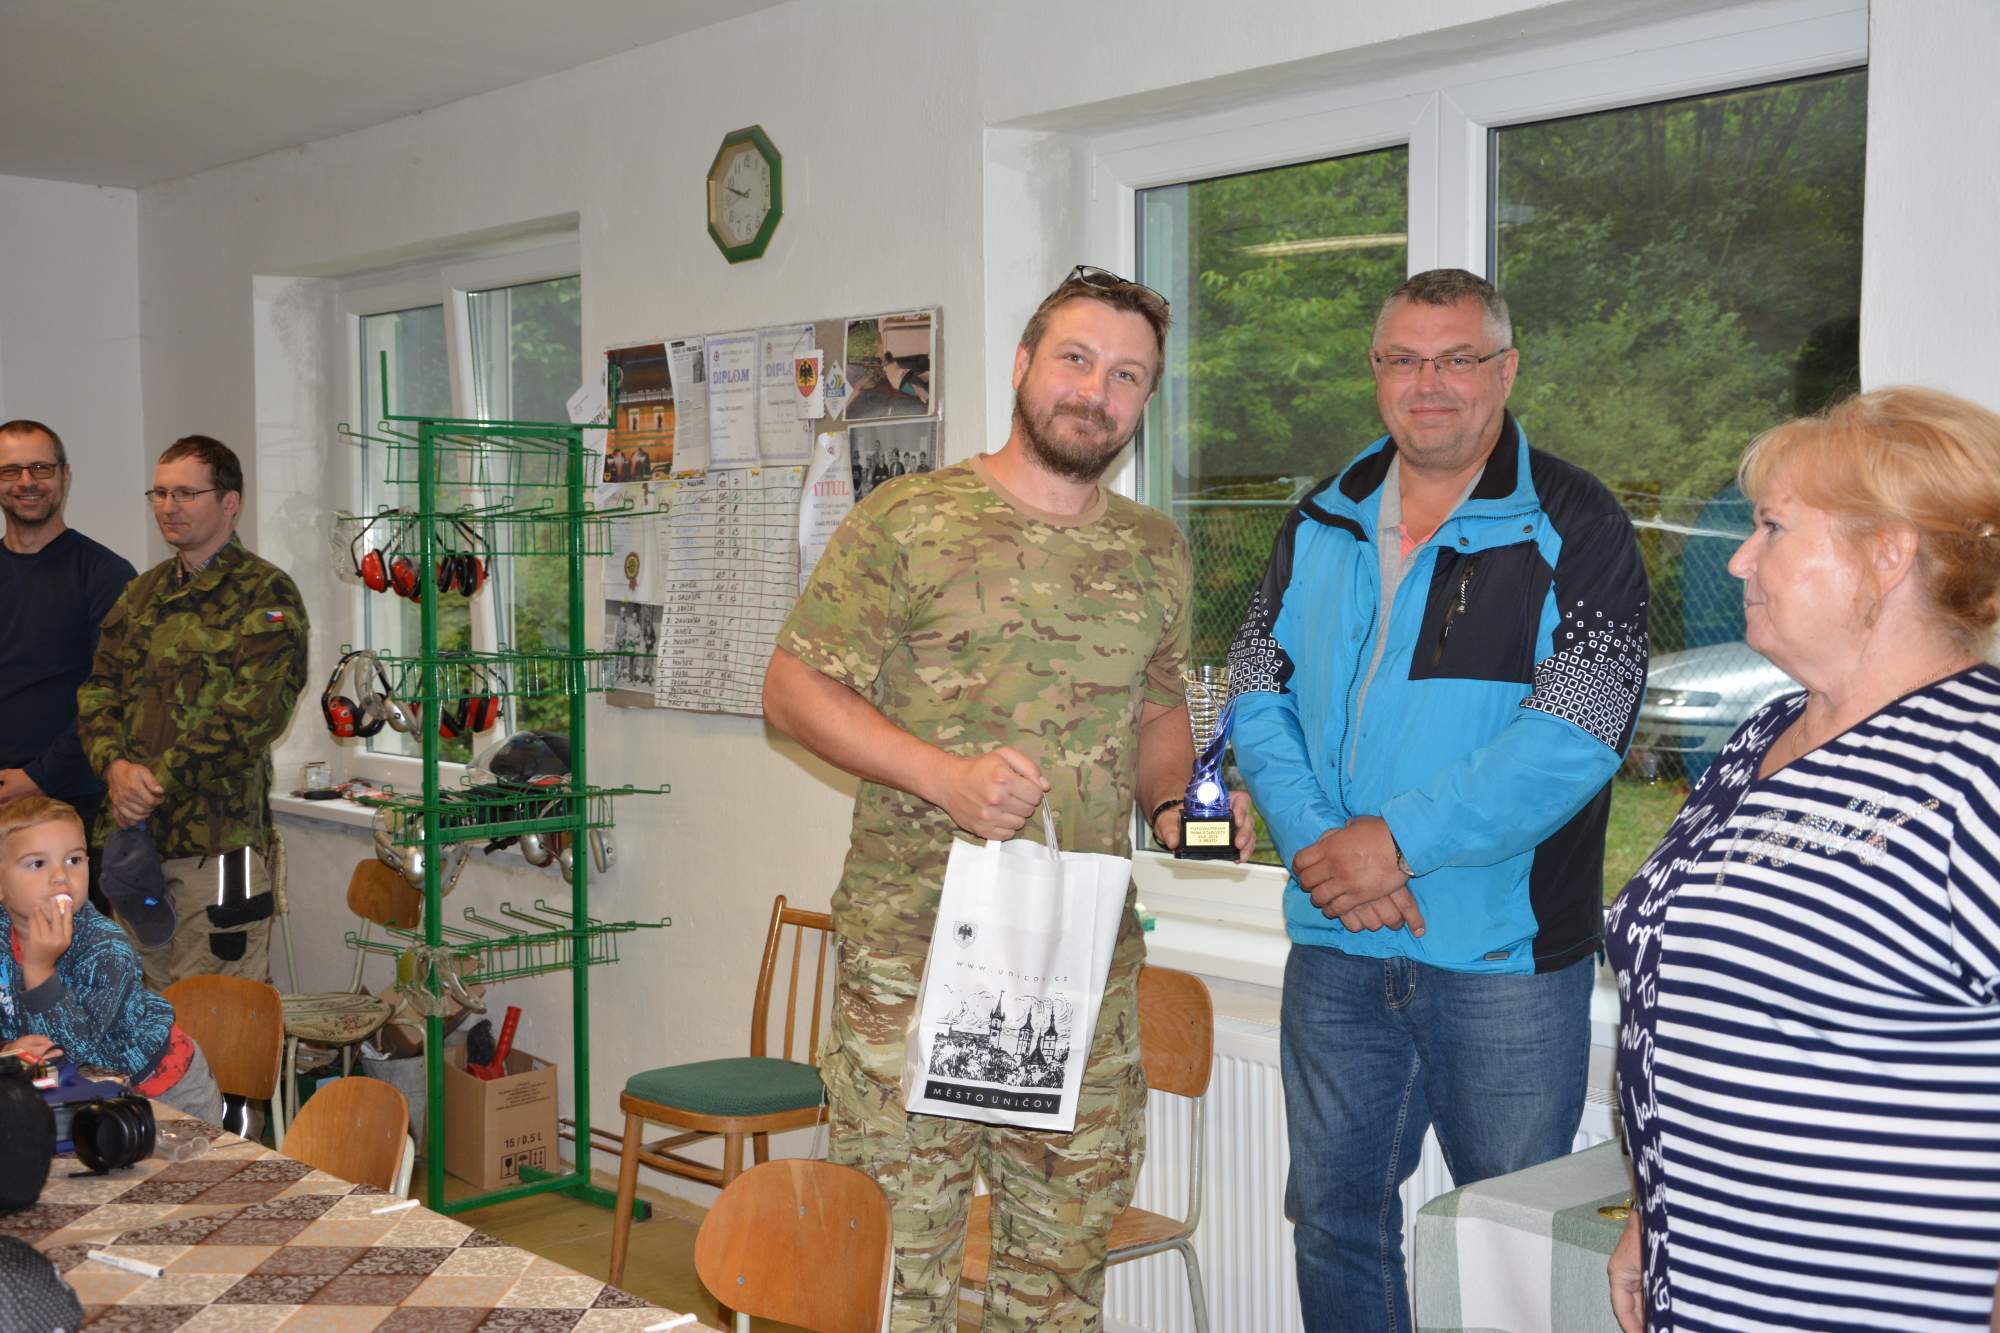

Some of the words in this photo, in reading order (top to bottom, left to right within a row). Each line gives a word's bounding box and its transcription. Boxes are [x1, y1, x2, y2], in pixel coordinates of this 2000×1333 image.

[713, 368, 750, 385] DIPLOM
[766, 361, 794, 377] DIPLO
[932, 1087, 985, 1103] MĚSTO
[991, 1095, 1054, 1109] UNIČOV
